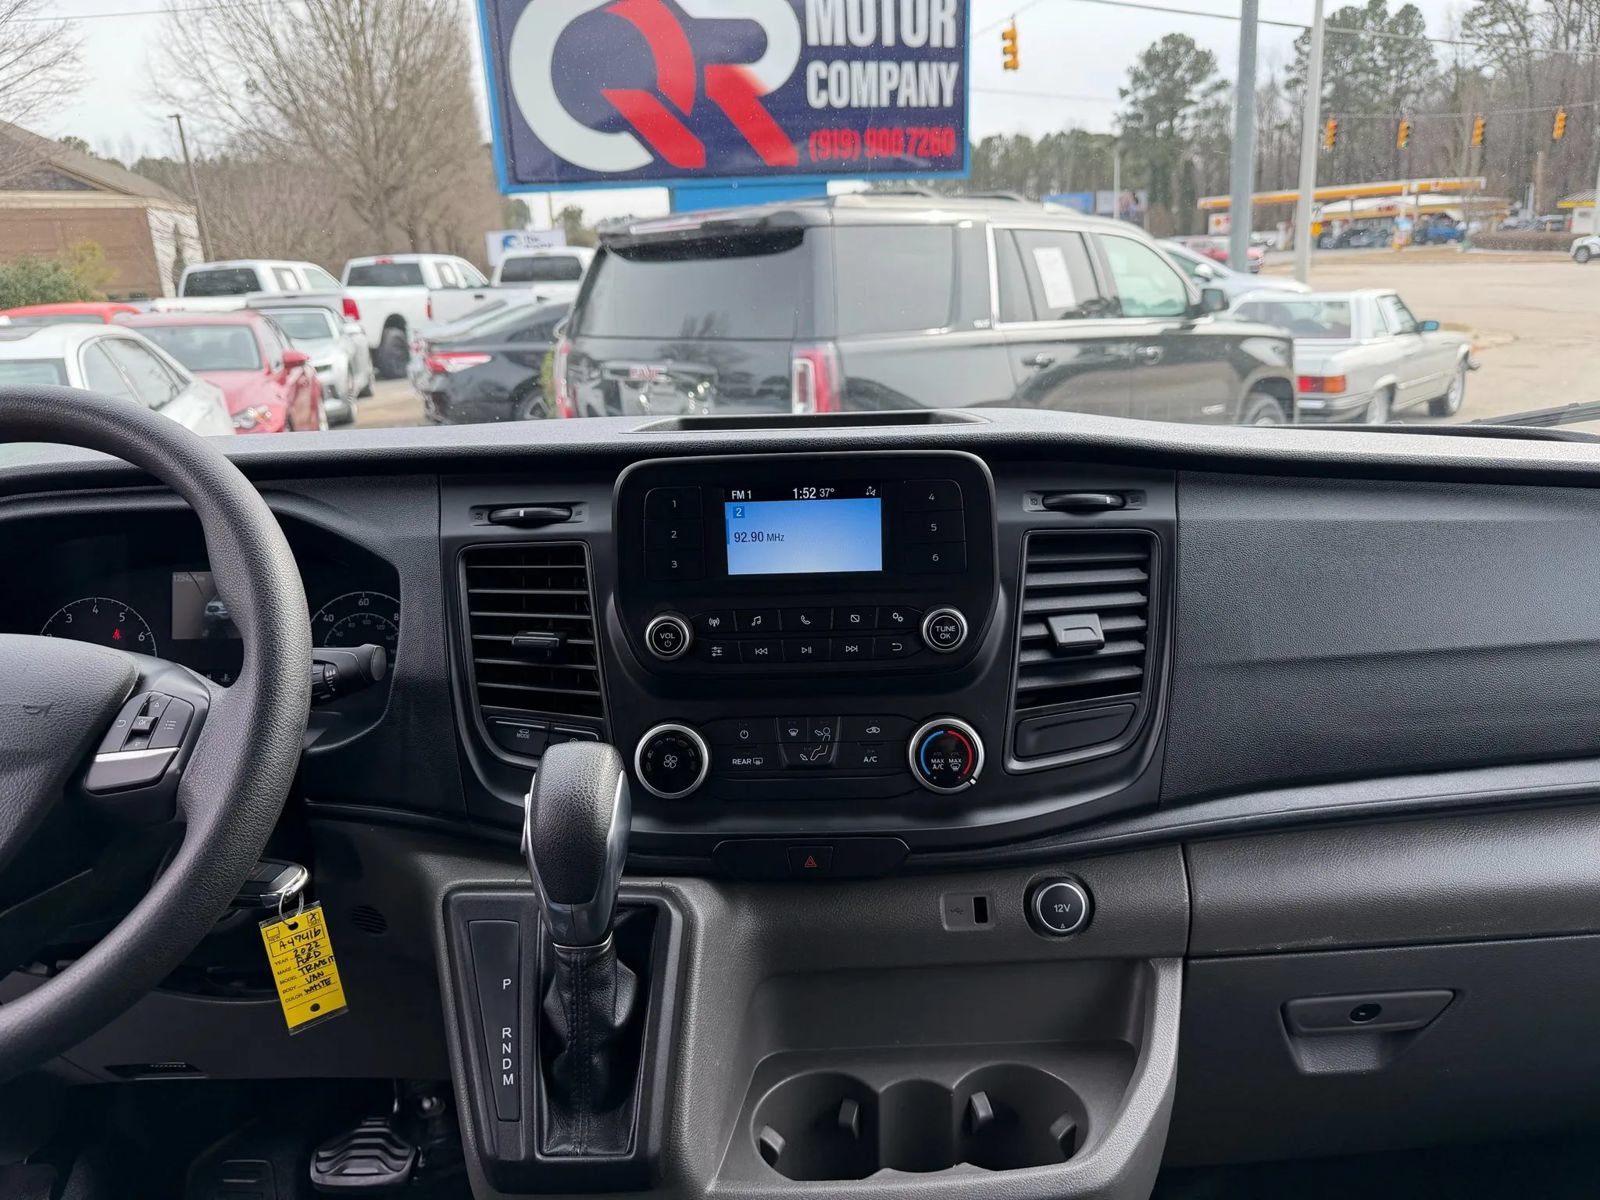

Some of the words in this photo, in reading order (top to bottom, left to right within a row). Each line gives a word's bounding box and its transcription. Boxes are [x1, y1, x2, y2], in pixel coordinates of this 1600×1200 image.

[805, 0, 958, 48] MOTOR
[806, 60, 959, 109] COMPANY
[808, 130, 861, 162] (919)
[864, 127, 904, 157] 900
[731, 490, 745, 500] FM
[792, 487, 817, 499] 1:52
[819, 488, 835, 498] 37°
[928, 493, 935, 501] 4
[735, 507, 742, 517] 2
[930, 523, 937, 532] 5
[671, 530, 678, 539] 2
[734, 531, 764, 543] 92.90
[766, 533, 785, 542] MHz
[932, 553, 939, 562] 6
[671, 560, 678, 569] 3
[358, 597, 370, 606] 60
[92, 605, 99, 614] 4
[65, 613, 73, 623] 3
[119, 612, 126, 622] 5
[323, 613, 335, 622] 40
[138, 631, 145, 642] 6
[659, 632, 676, 640] VOL
[940, 632, 951, 640] OK
[1053, 903, 1071, 913] 12V
[293, 940, 321, 958] 2022
[304, 971, 325, 984] VAN
[303, 977, 331, 994] WHITE
[502, 978, 512, 990] P
[502, 1027, 512, 1039] R
[502, 1042, 512, 1055] N
[502, 1058, 512, 1070] D
[503, 1073, 514, 1086] M
